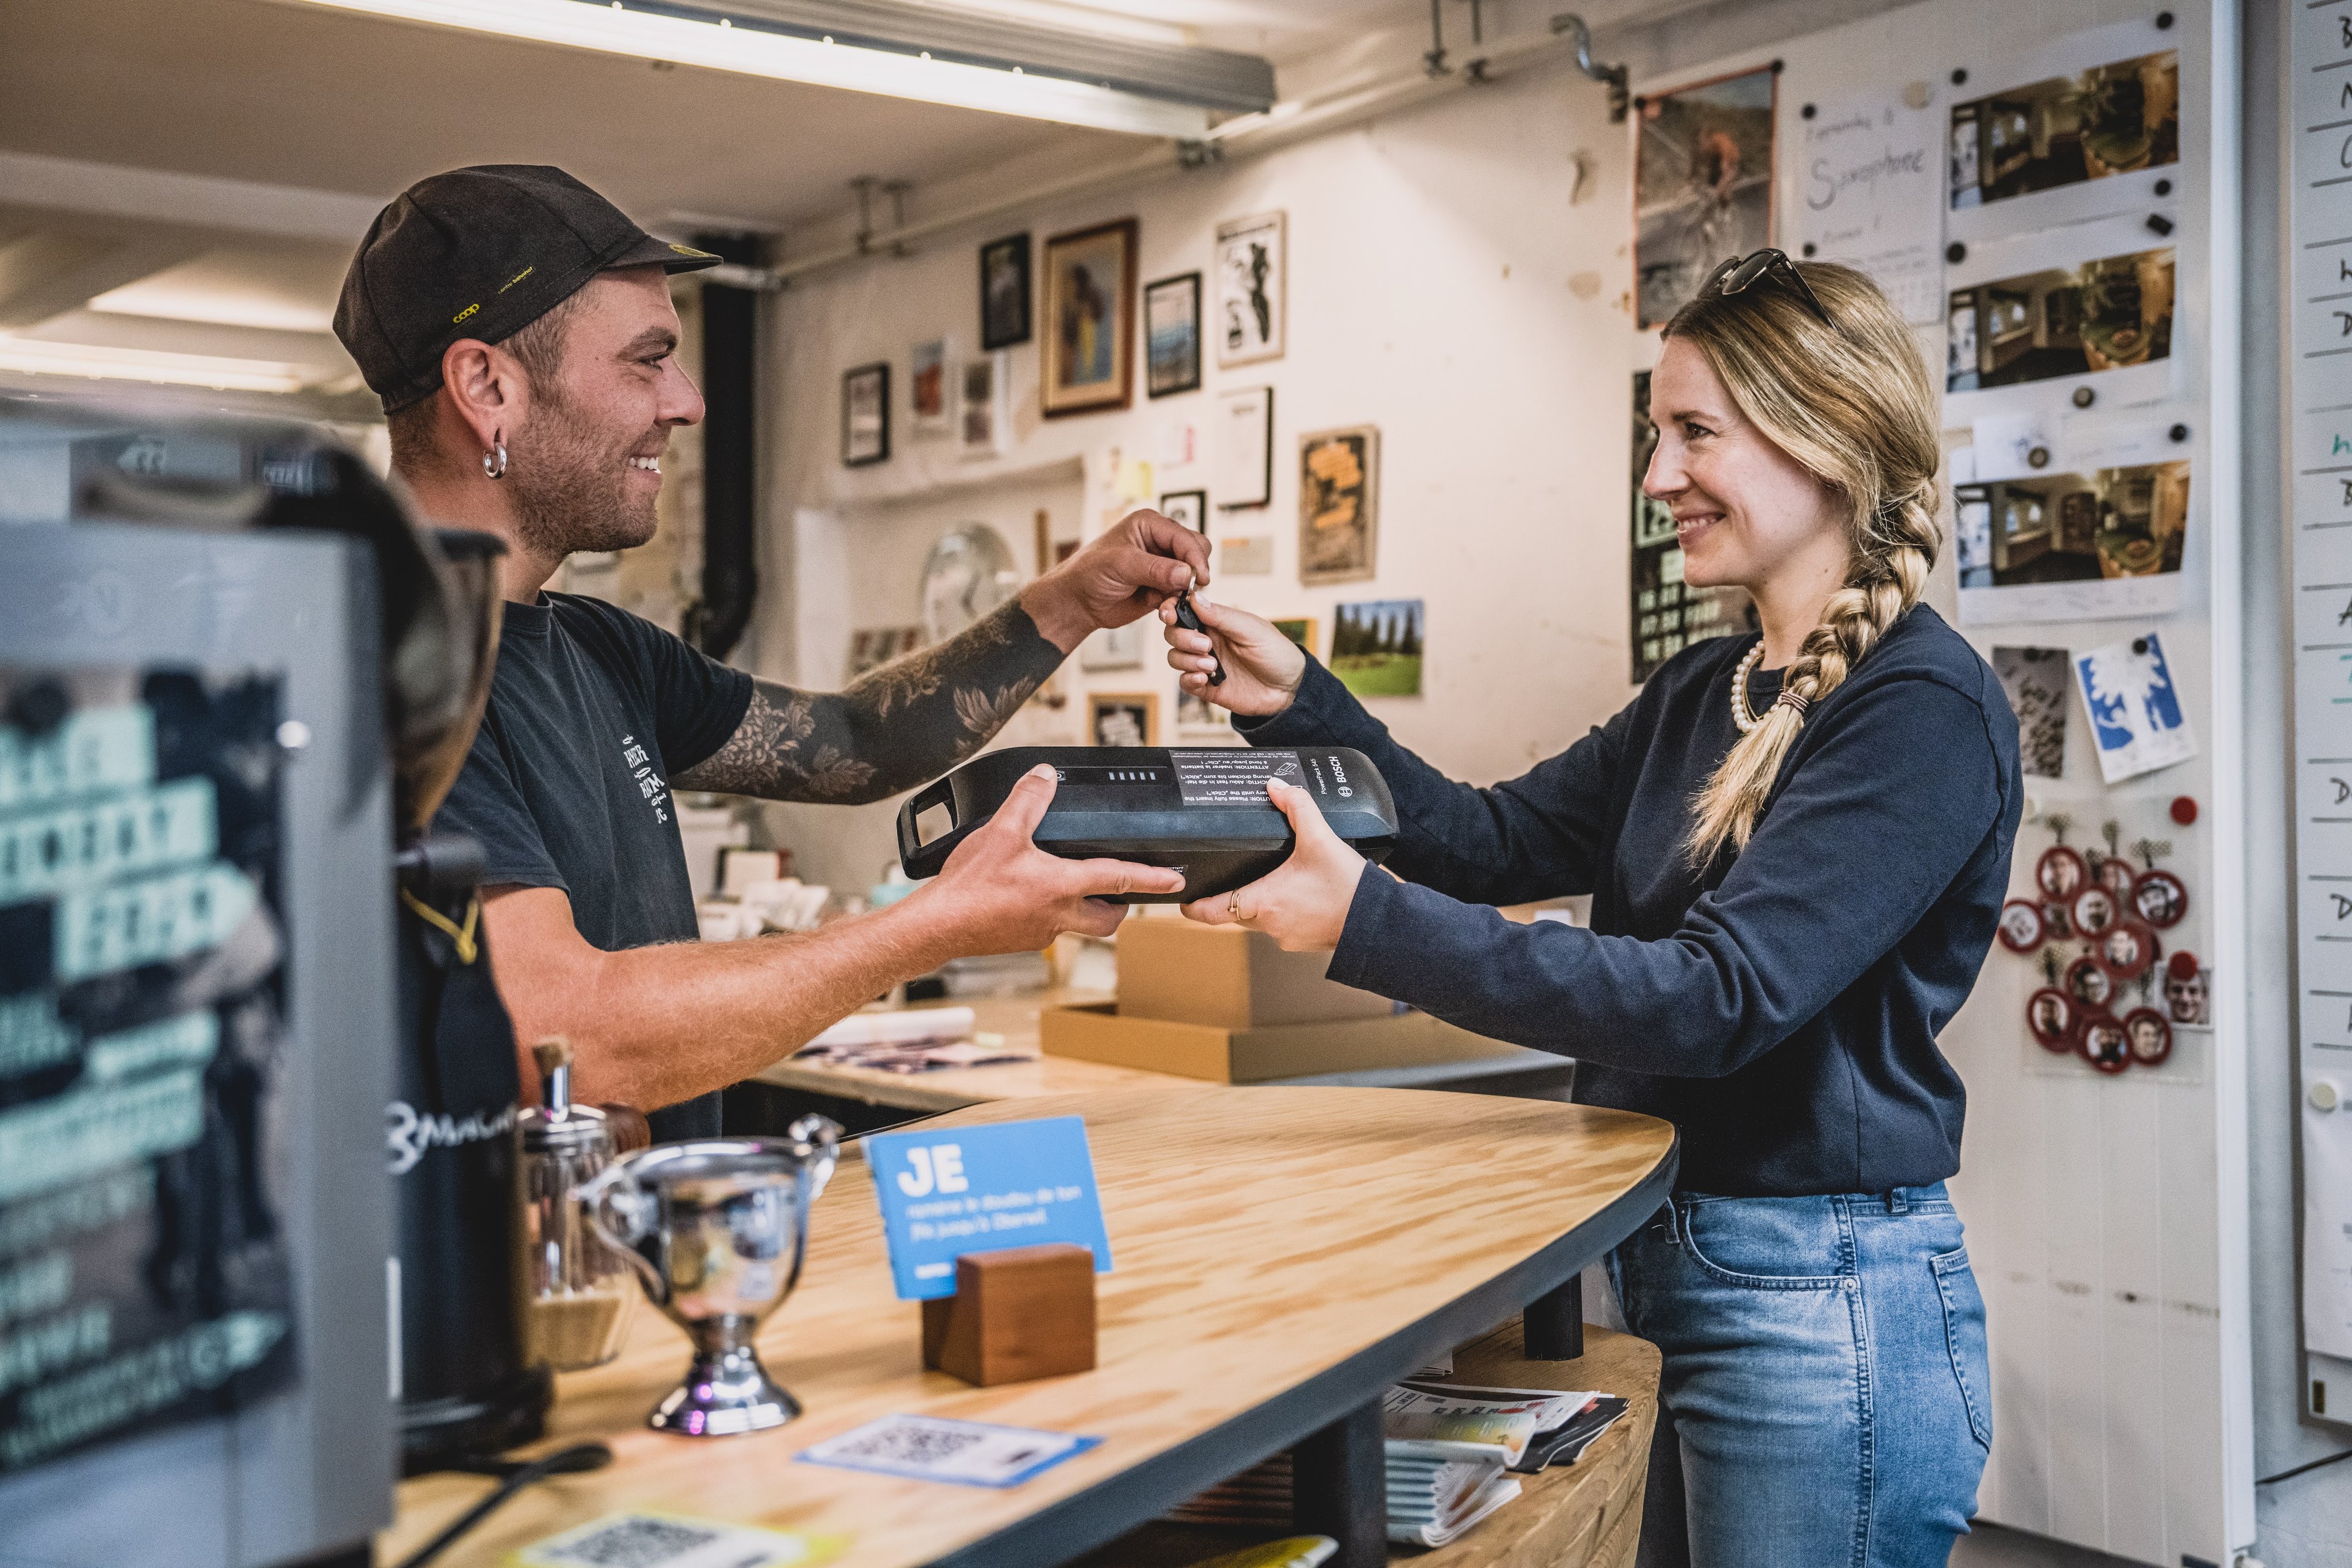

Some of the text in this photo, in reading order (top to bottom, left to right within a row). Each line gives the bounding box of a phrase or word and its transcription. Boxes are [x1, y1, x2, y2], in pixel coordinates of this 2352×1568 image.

[512, 266, 533, 284] bahnhof
[452, 303, 480, 324] coop
[1310, 758, 1328, 795] PowerPack 545
[1328, 756, 1347, 783] BOSCH
[896, 1143, 969, 1198] JE
